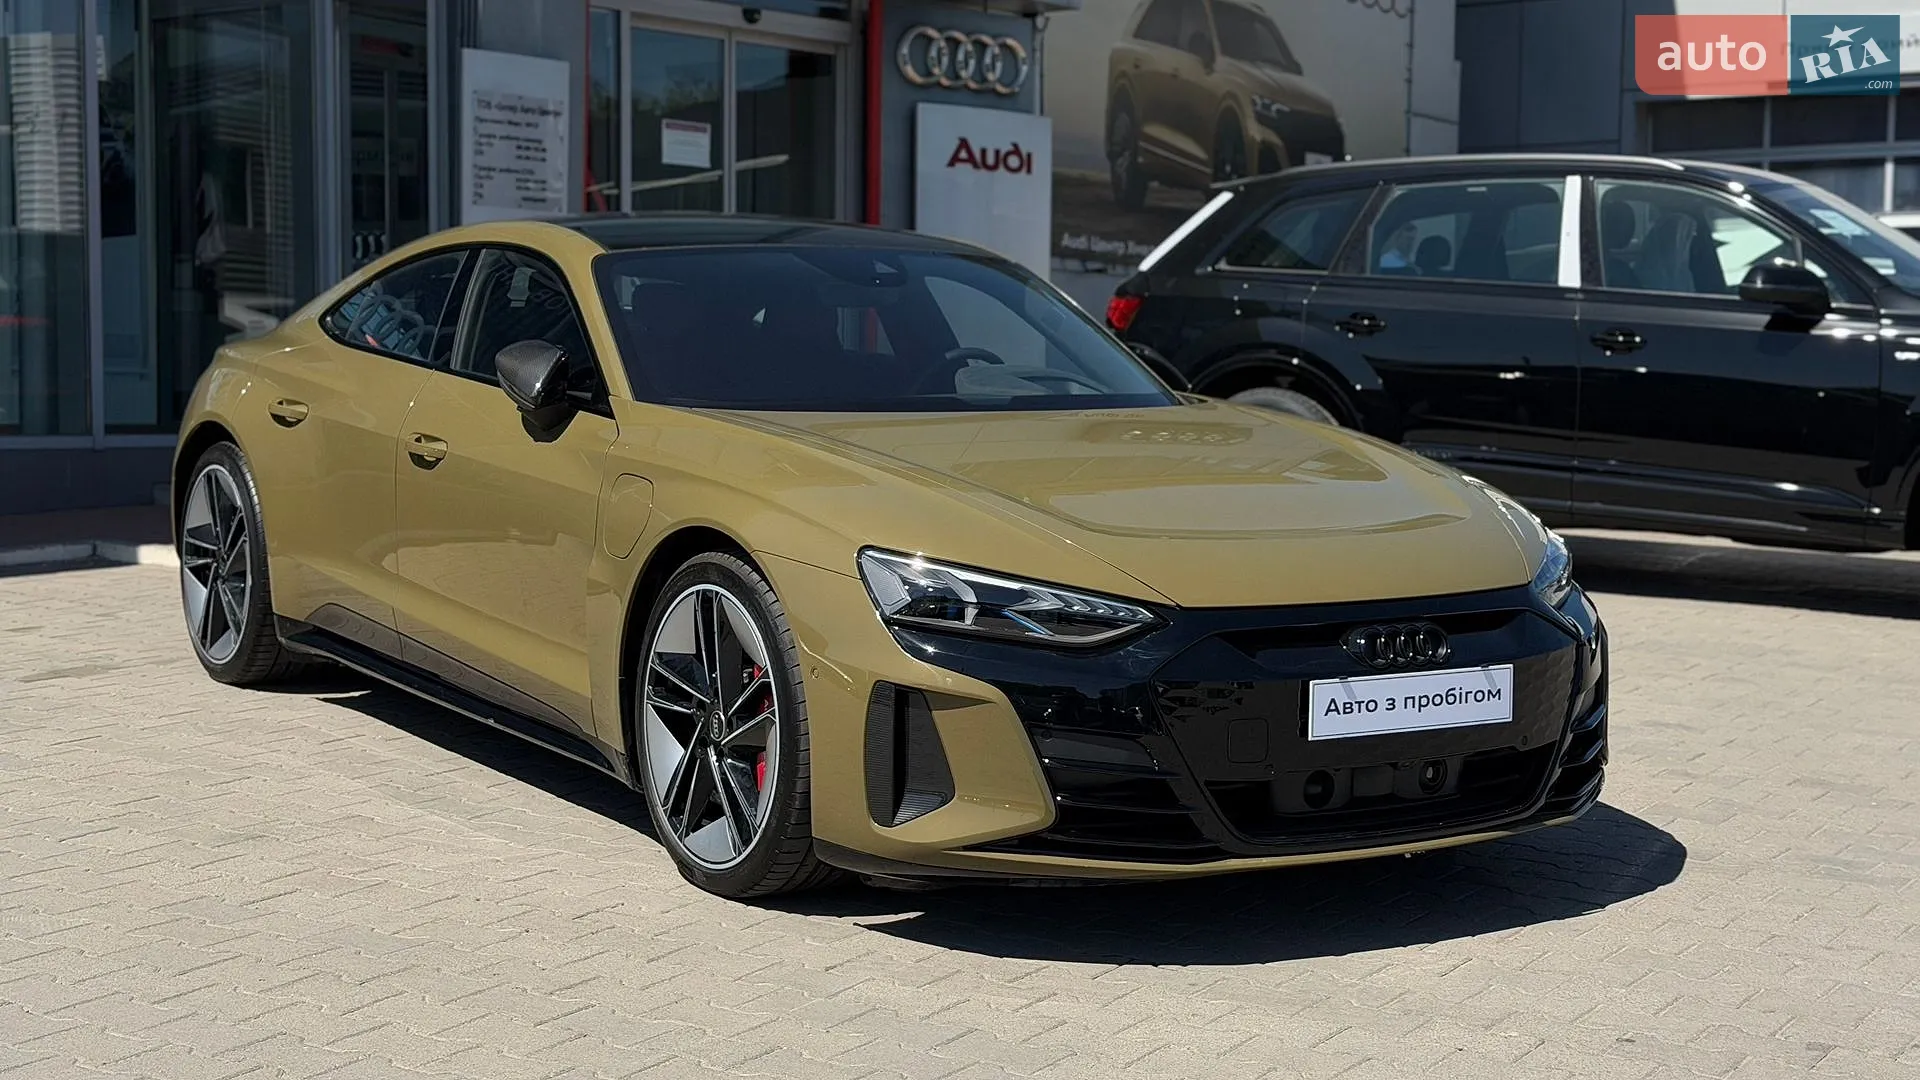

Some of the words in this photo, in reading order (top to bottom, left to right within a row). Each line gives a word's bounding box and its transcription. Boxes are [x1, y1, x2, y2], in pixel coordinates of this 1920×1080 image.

[947, 137, 1033, 175] Audi
[1324, 697, 1378, 717] Авто
[1385, 697, 1396, 711] з
[1404, 686, 1502, 713] пробігом
